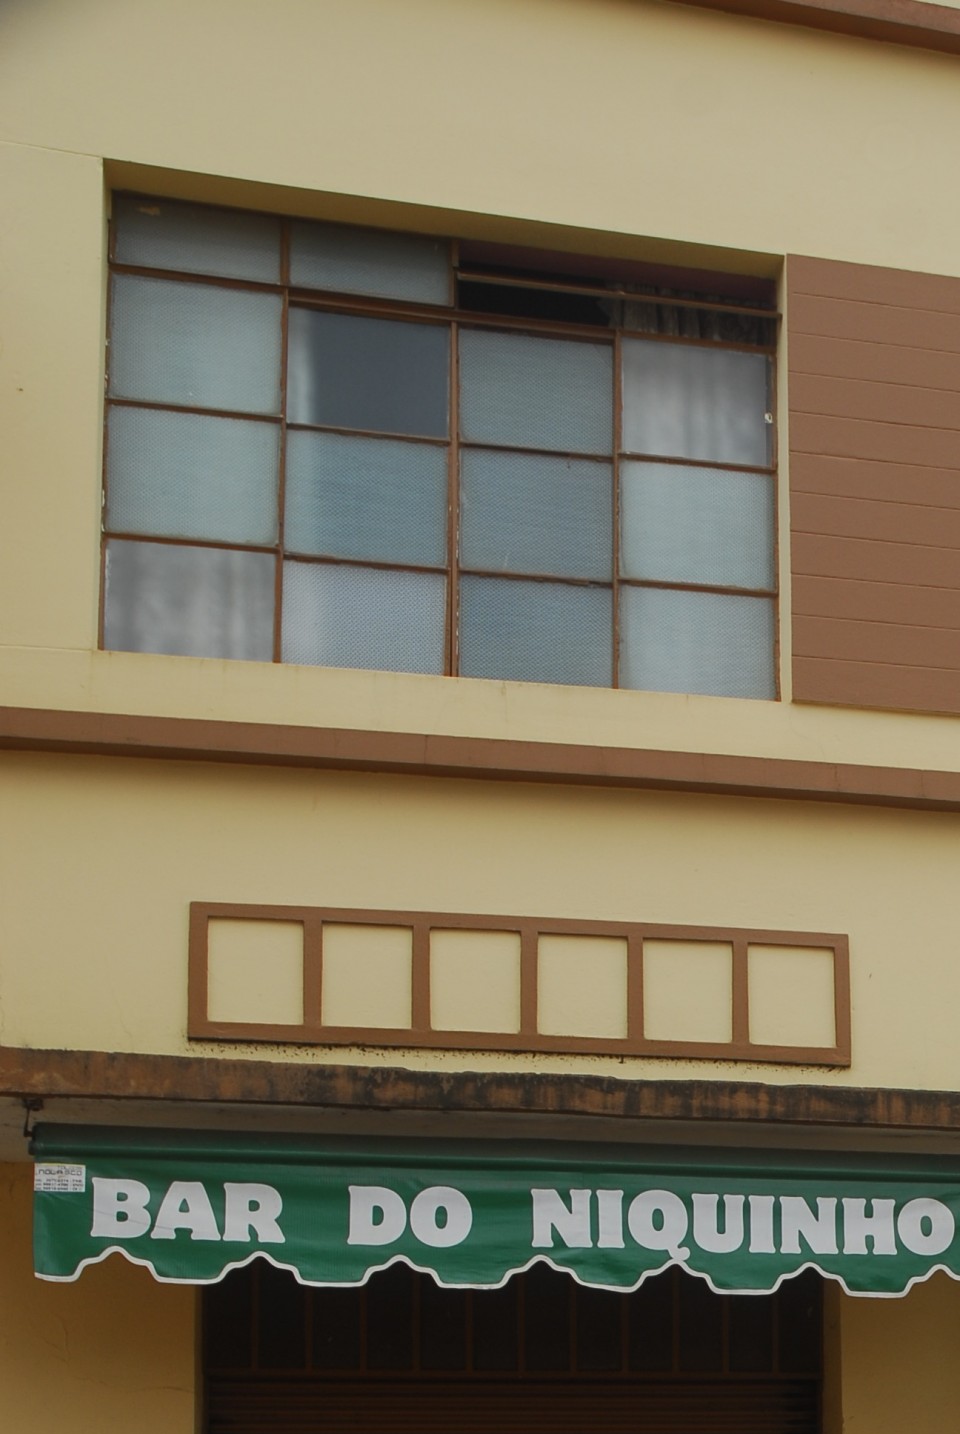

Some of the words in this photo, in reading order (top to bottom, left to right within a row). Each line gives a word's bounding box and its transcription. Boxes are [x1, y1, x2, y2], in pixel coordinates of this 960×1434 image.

[91, 1177, 286, 1243] BAR
[347, 1185, 473, 1248] DO
[531, 1188, 955, 1261] NIQUINHO
